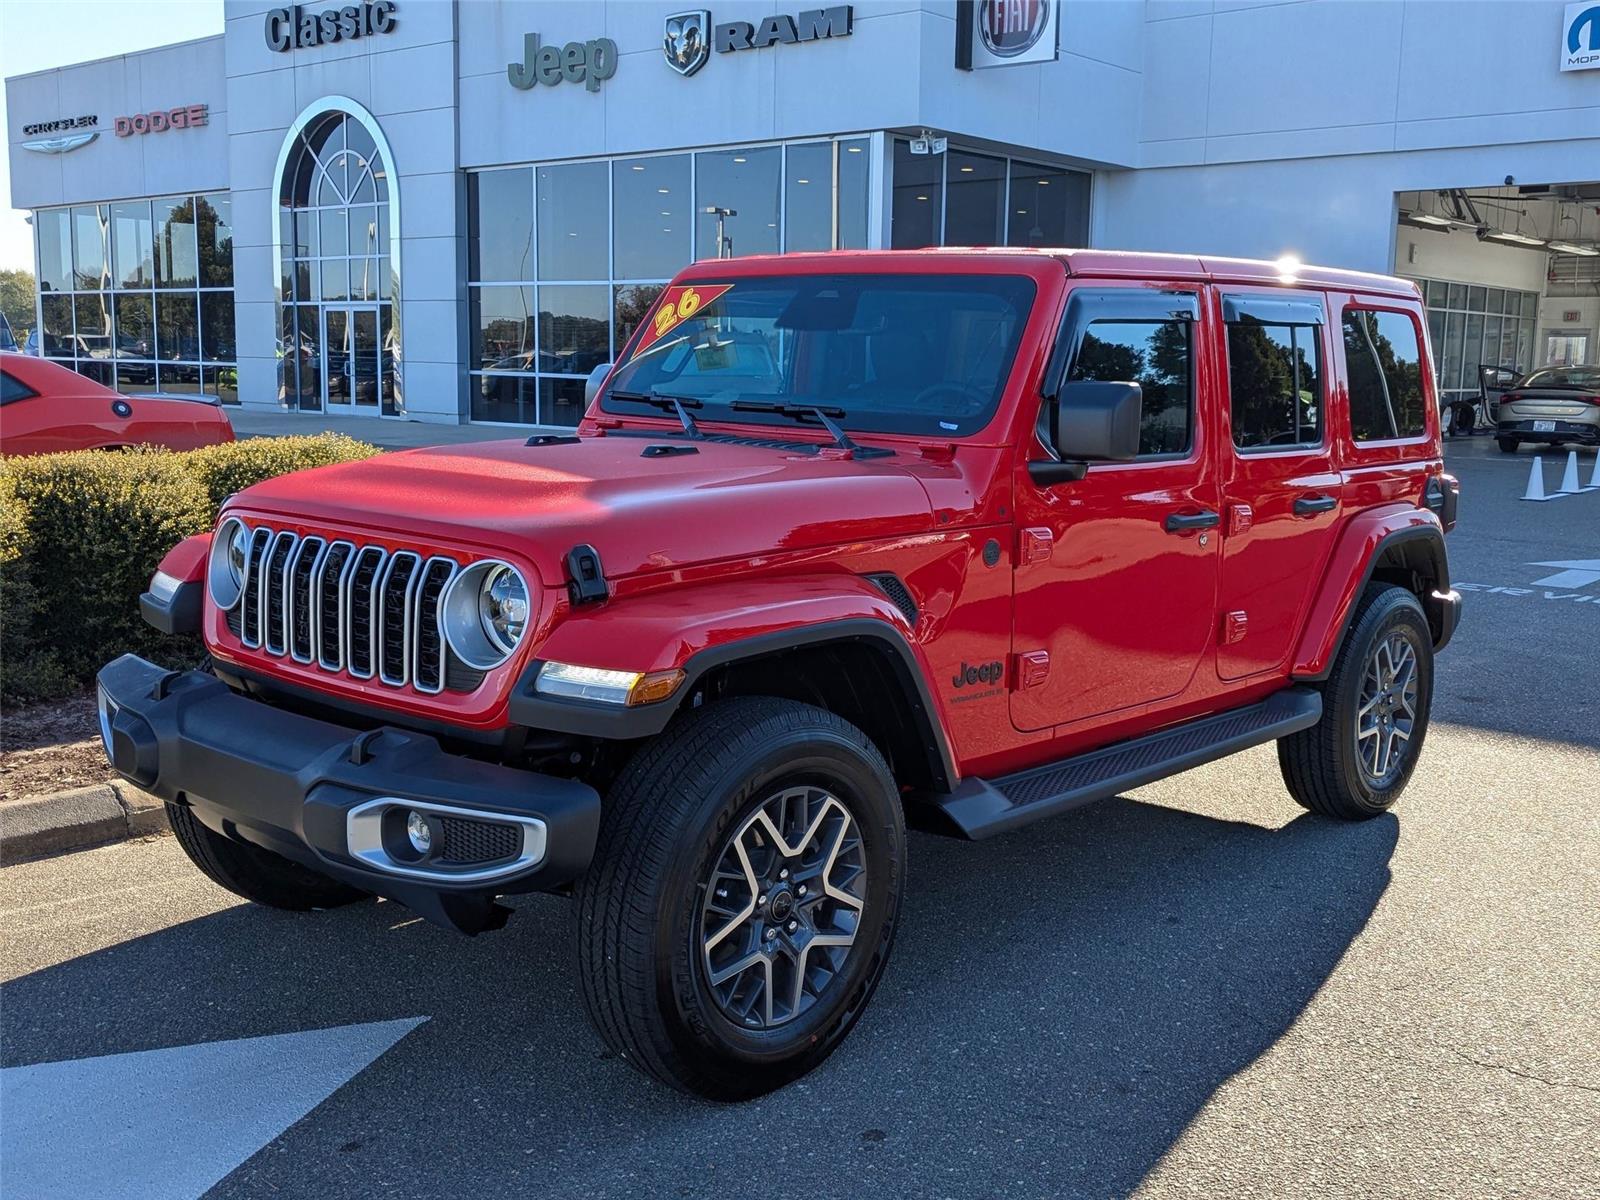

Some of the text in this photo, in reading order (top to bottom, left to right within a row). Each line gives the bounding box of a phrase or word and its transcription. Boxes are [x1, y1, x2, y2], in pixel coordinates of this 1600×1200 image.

[265, 0, 398, 53] Classic
[715, 5, 853, 53] RAM
[507, 32, 618, 92] Jeep
[22, 114, 98, 136] CHRYSLER
[113, 104, 209, 138] DODGE
[654, 287, 701, 337] 26
[952, 661, 1003, 688] Jeep
